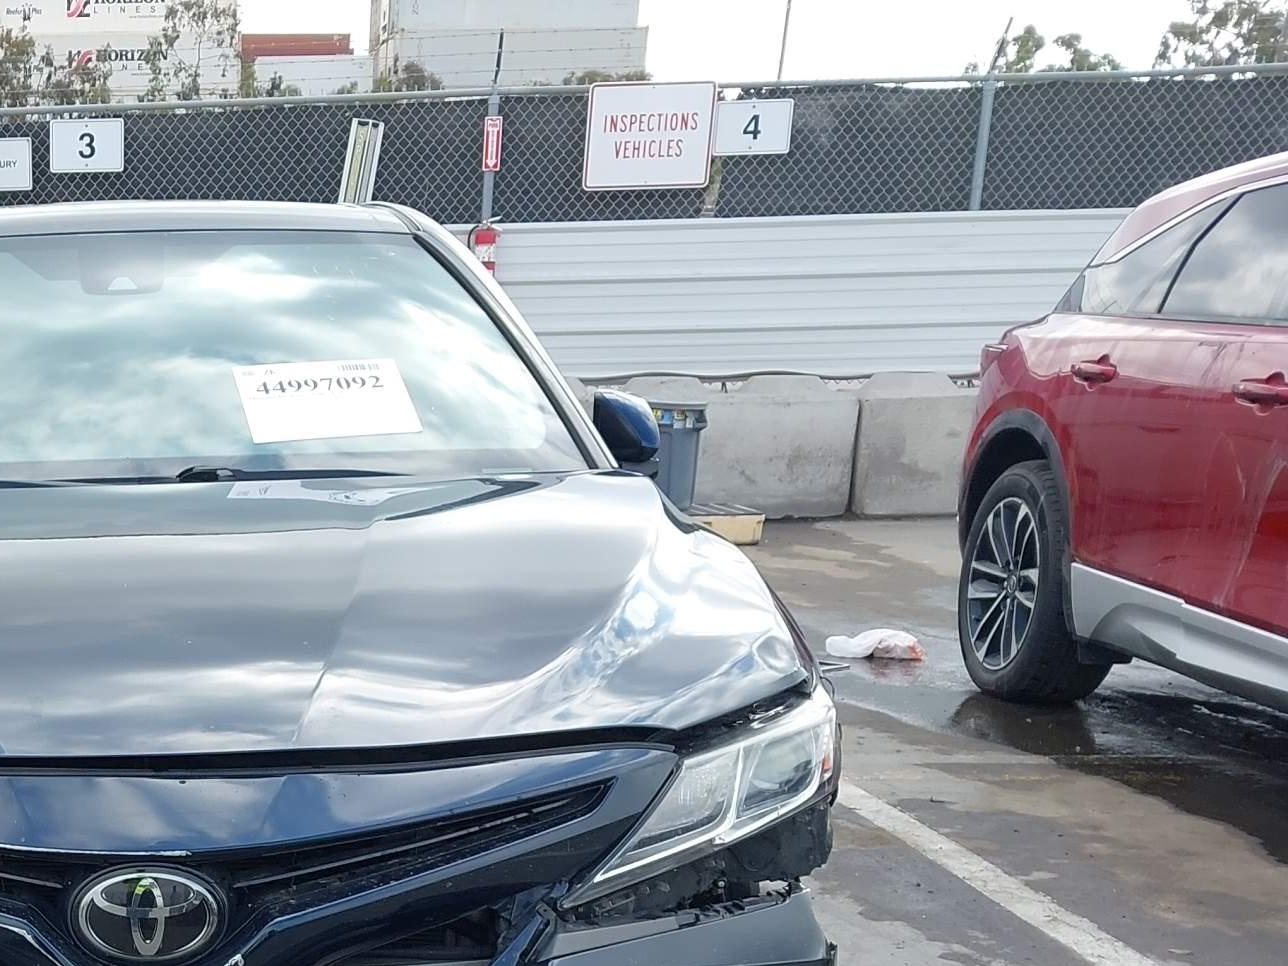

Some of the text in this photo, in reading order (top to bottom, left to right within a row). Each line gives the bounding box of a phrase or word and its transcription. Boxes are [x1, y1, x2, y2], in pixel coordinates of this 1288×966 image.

[604, 112, 698, 133] INSPECTIONS
[743, 114, 761, 140] 4
[78, 132, 96, 159] 3
[614, 138, 684, 159] VEHICLES
[256, 375, 384, 394] 44997092
